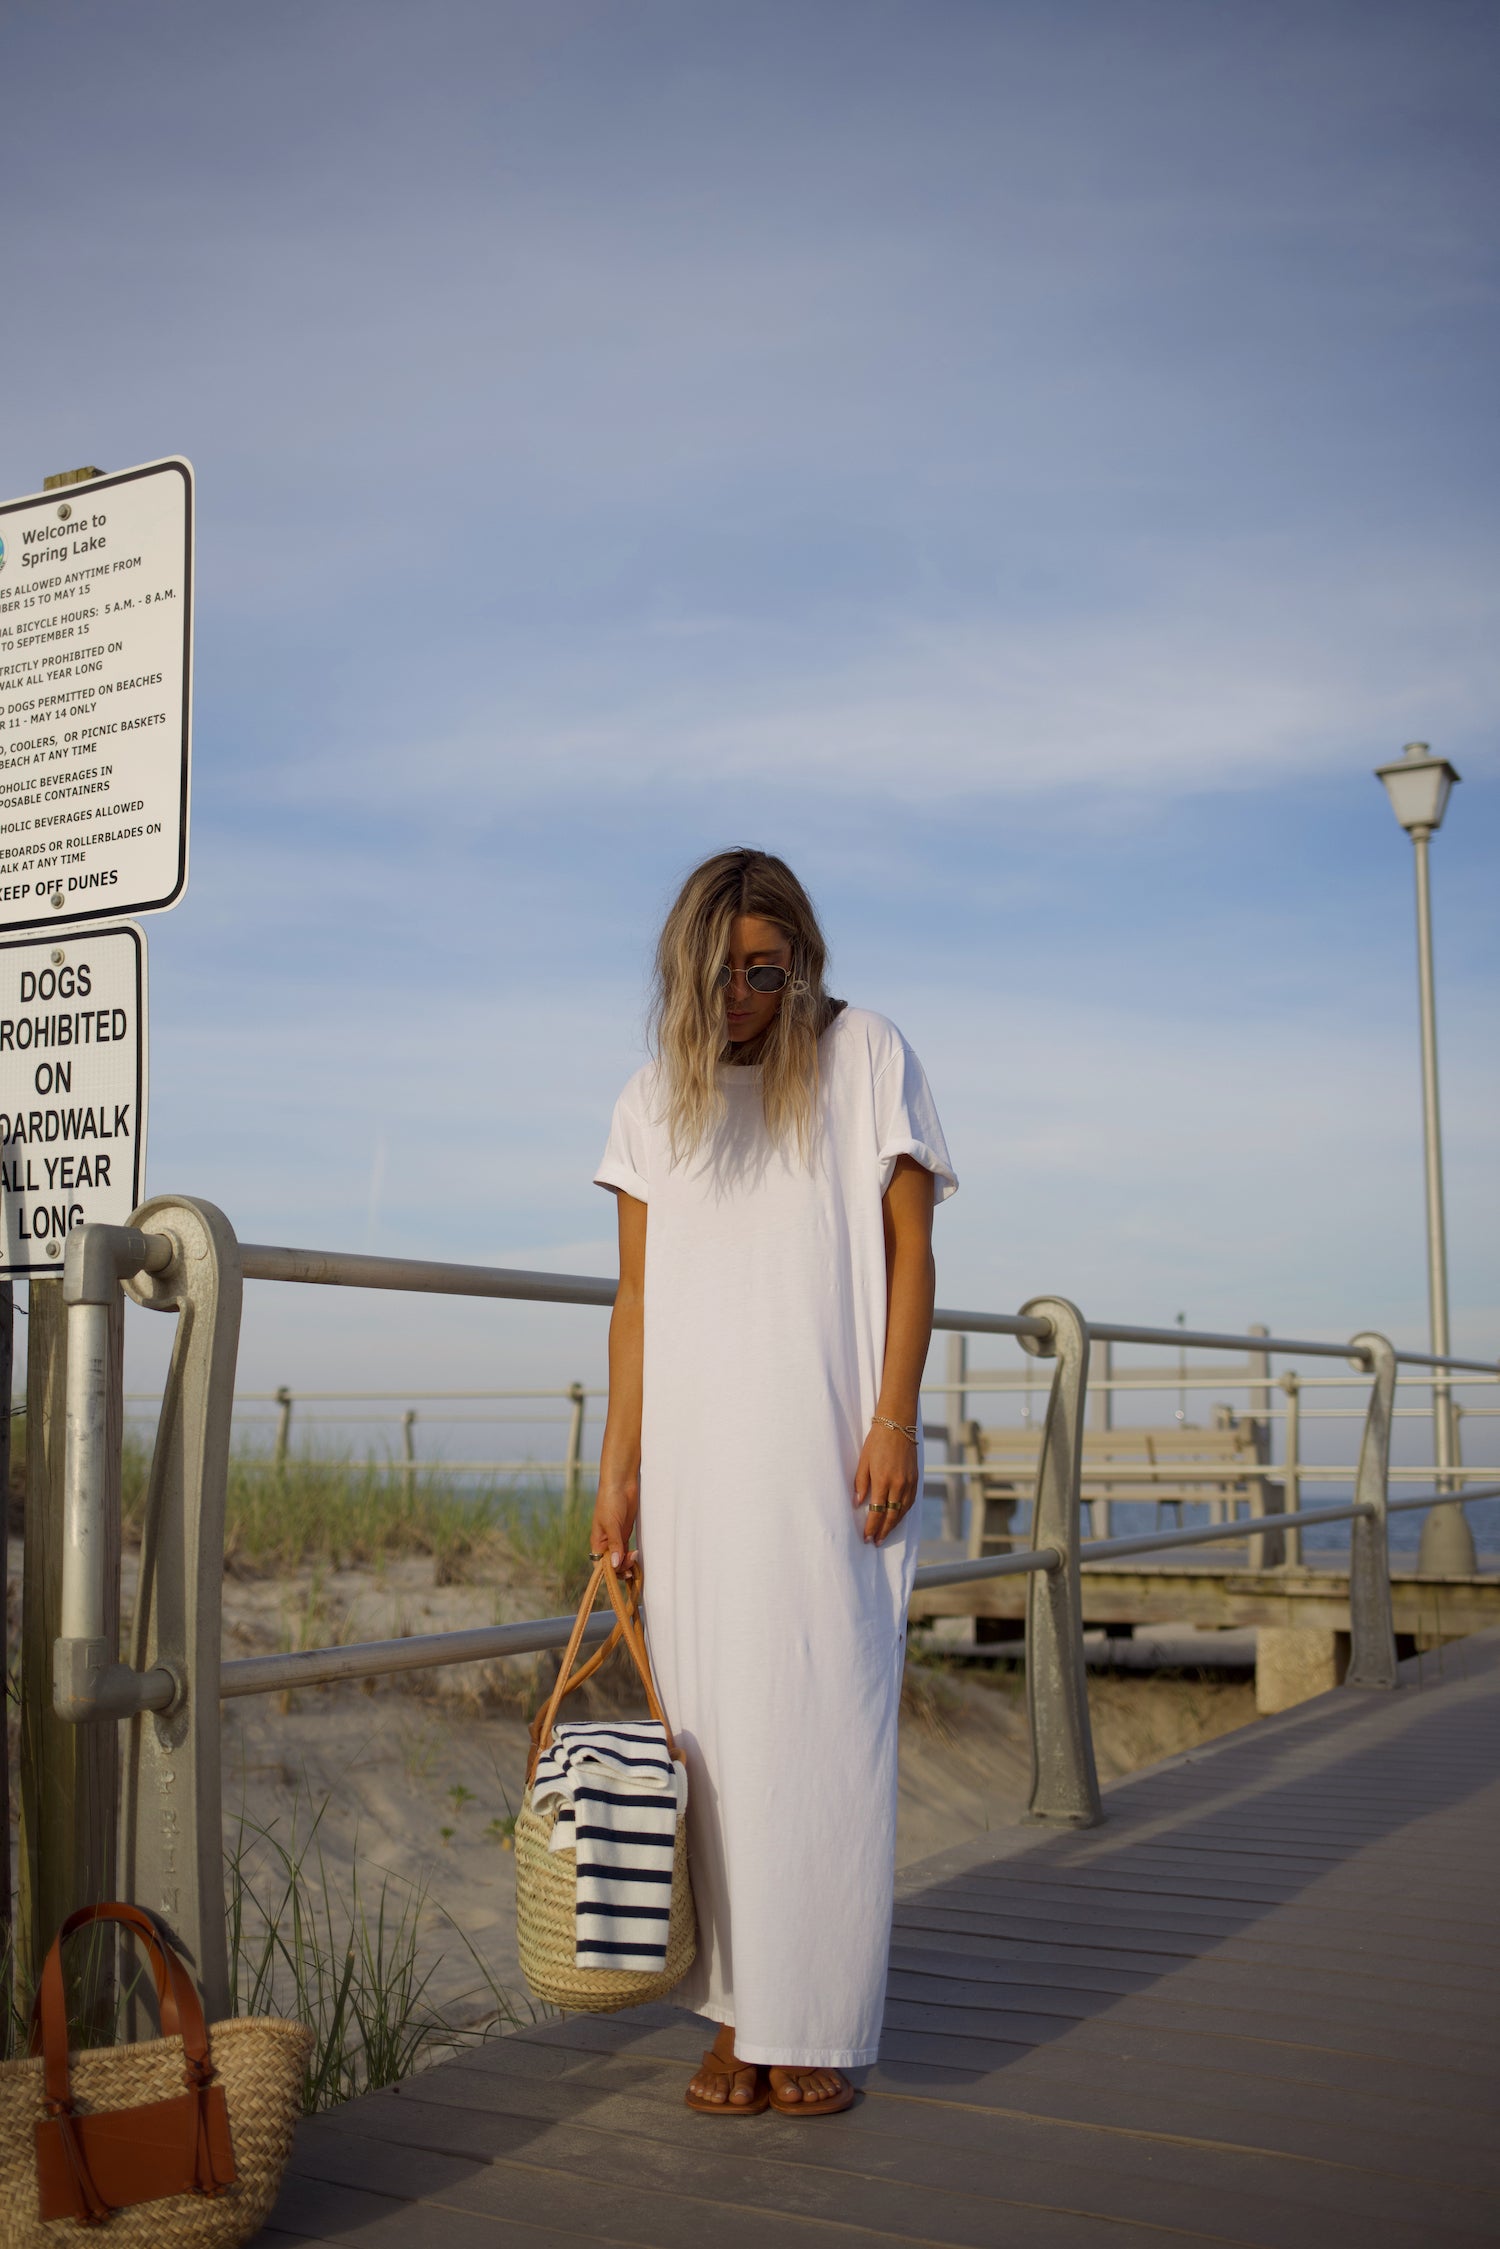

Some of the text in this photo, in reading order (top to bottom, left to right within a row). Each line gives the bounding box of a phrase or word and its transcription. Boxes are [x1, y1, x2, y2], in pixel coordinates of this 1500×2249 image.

[23, 514, 107, 545] Welcome to
[22, 546, 68, 568] Spring
[73, 537, 106, 555] Lake
[15, 576, 62, 596] ALLOWED
[65, 564, 110, 584] ANYTIME
[113, 557, 141, 572] FROM
[24, 596, 35, 607] 15
[39, 594, 51, 604] TO
[54, 587, 77, 601] MAY
[79, 584, 90, 595] 15
[0, 627, 13, 638] AL
[17, 617, 57, 633] BICYCLE
[61, 608, 98, 624] HOURS:
[105, 605, 110, 614] 5
[114, 598, 135, 612] A.M.
[146, 595, 151, 604] 8
[155, 589, 176, 602] A.M.
[2, 624, 89, 652] TO SEPTEMBER 15
[42, 645, 104, 668] PROHIBITED
[108, 642, 123, 653] ON
[27, 674, 43, 685] ALL
[47, 668, 72, 681] YEAR
[76, 661, 103, 675] LONG
[8, 699, 35, 713] DOGS
[38, 688, 95, 707] PERMITTED
[99, 684, 113, 695] ON
[117, 673, 162, 692] BEACHES
[9, 719, 19, 728] 11
[31, 712, 52, 724] MAY
[55, 709, 66, 719] 14
[70, 702, 96, 716] ONLY
[10, 736, 58, 753] COOLERS,
[64, 732, 78, 742] OR
[82, 724, 117, 739] PICNIC
[121, 713, 166, 731] BASKETS
[34, 753, 45, 762] AT
[49, 749, 69, 760] ANY
[72, 743, 97, 756] TIME
[40, 769, 97, 787] BEVERAGES
[101, 765, 113, 775] IN
[45, 781, 110, 801] CONTAINERS
[35, 810, 92, 828] BEVERAGES
[95, 801, 144, 817] ALLOWED
[49, 841, 62, 850] OR
[66, 826, 143, 848] ROLLERBLADES
[147, 823, 161, 834] ON
[22, 860, 34, 870] AT
[37, 857, 57, 868] ANY
[61, 852, 85, 863] TIME
[36, 879, 63, 896] OFF
[68, 870, 118, 891] DUNES
[21, 964, 91, 1003] DOGS
[35, 1061, 71, 1094] ON
[44, 1155, 111, 1190] YEAR
[19, 1204, 84, 1239] LONG
